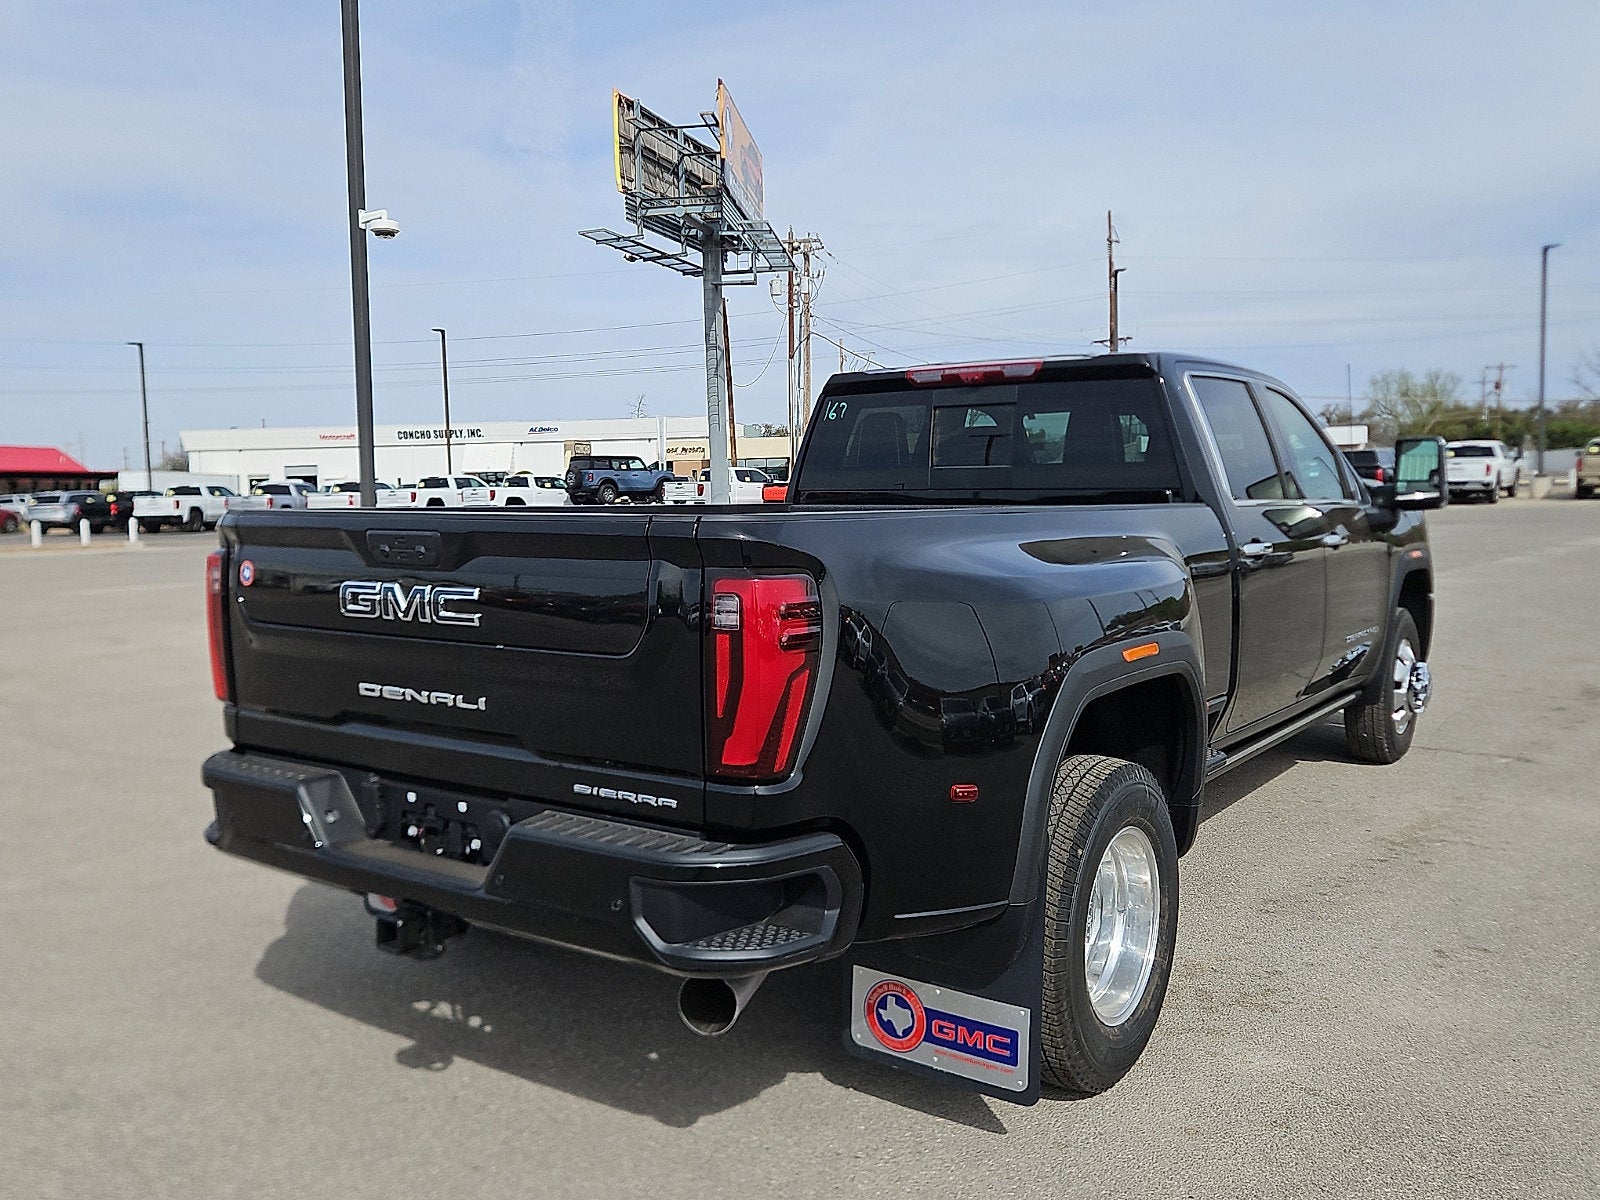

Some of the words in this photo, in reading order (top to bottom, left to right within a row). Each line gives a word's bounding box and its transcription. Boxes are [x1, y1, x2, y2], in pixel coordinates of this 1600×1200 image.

[824, 401, 848, 422] 167
[397, 430, 431, 440] CONCHO
[467, 429, 485, 438] INC.
[339, 581, 482, 627] GMC
[358, 682, 487, 711] DENALI
[572, 784, 679, 809] SIERRA
[932, 1019, 1011, 1057] GMC
